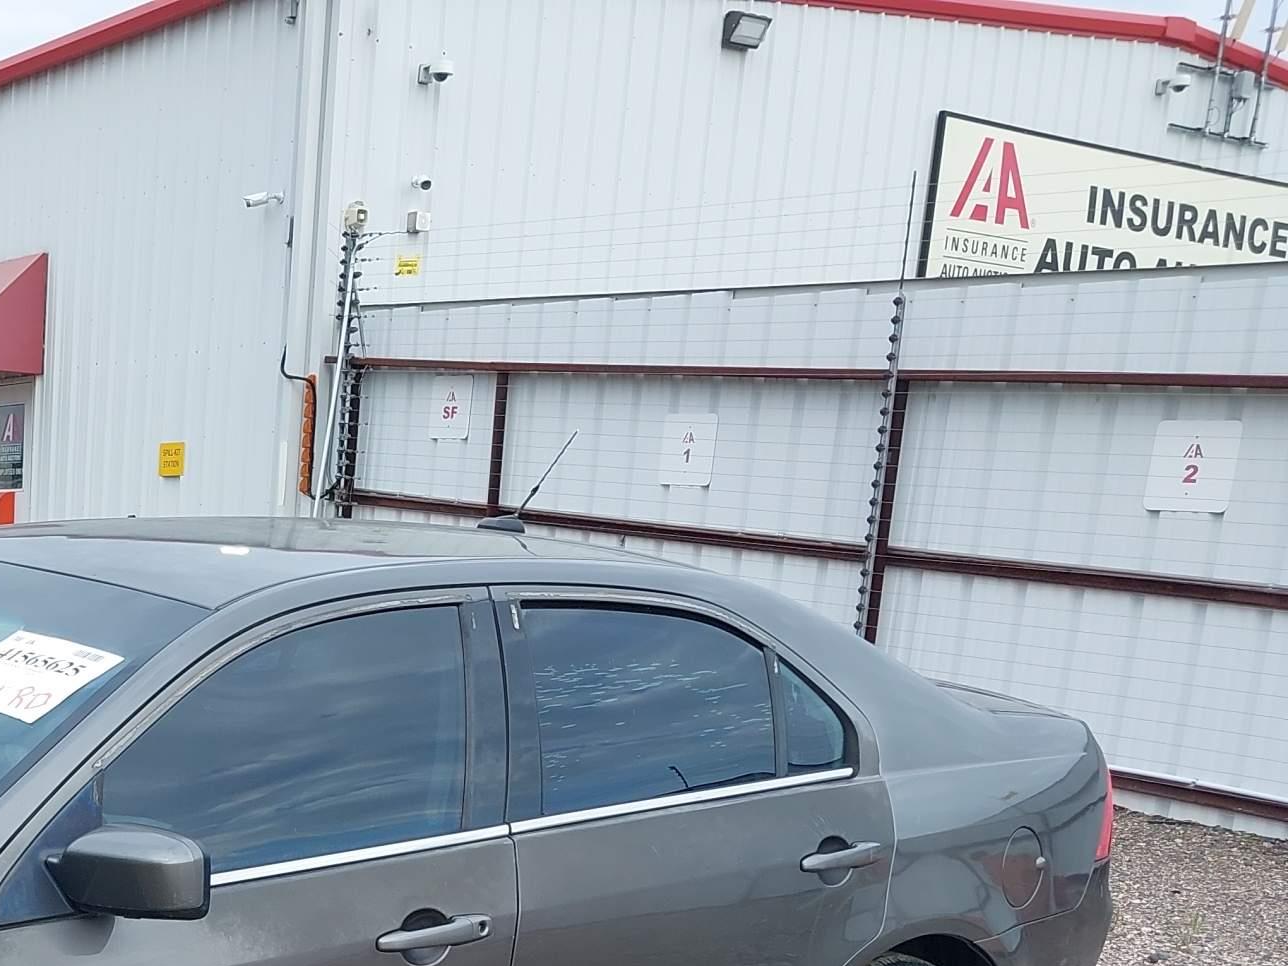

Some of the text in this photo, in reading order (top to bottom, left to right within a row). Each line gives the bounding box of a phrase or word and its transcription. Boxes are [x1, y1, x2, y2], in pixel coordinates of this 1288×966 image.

[1086, 185, 1288, 259] INSURANCE
[944, 236, 1027, 262] INSURANCE
[442, 406, 458, 420] SF
[683, 448, 691, 463] 1
[1182, 464, 1199, 484] 2
